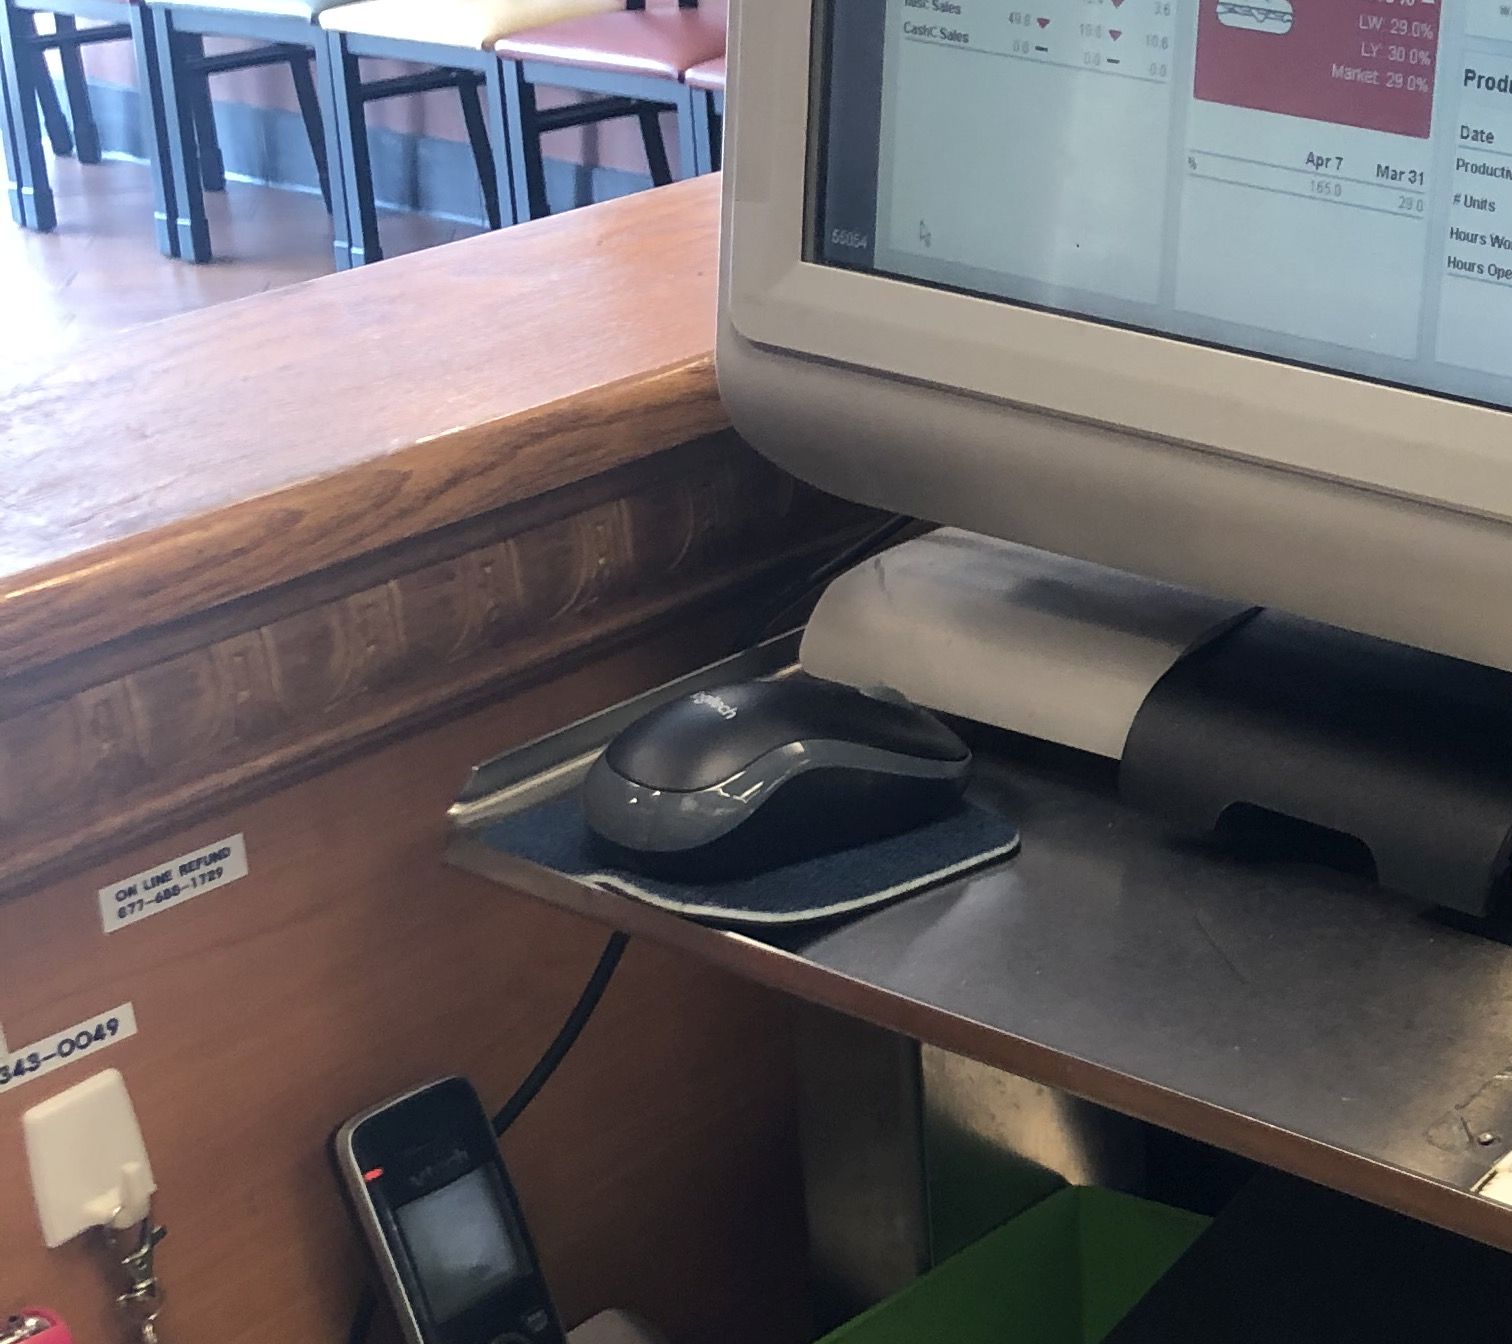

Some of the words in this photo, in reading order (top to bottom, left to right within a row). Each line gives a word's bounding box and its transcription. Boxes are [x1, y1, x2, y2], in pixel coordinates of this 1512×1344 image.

[939, 26, 970, 44] Sales
[1459, 124, 1495, 145] Date
[1305, 151, 1331, 171] Apr
[1335, 155, 1344, 170] 7
[1375, 163, 1405, 182] Mar
[1407, 167, 1425, 186] 31
[1463, 193, 1497, 213] Units
[1449, 226, 1487, 246] Hours
[1447, 255, 1485, 274] Hours
[114, 884, 137, 903] ON
[144, 870, 173, 891] LINE
[179, 846, 232, 877] REFUND
